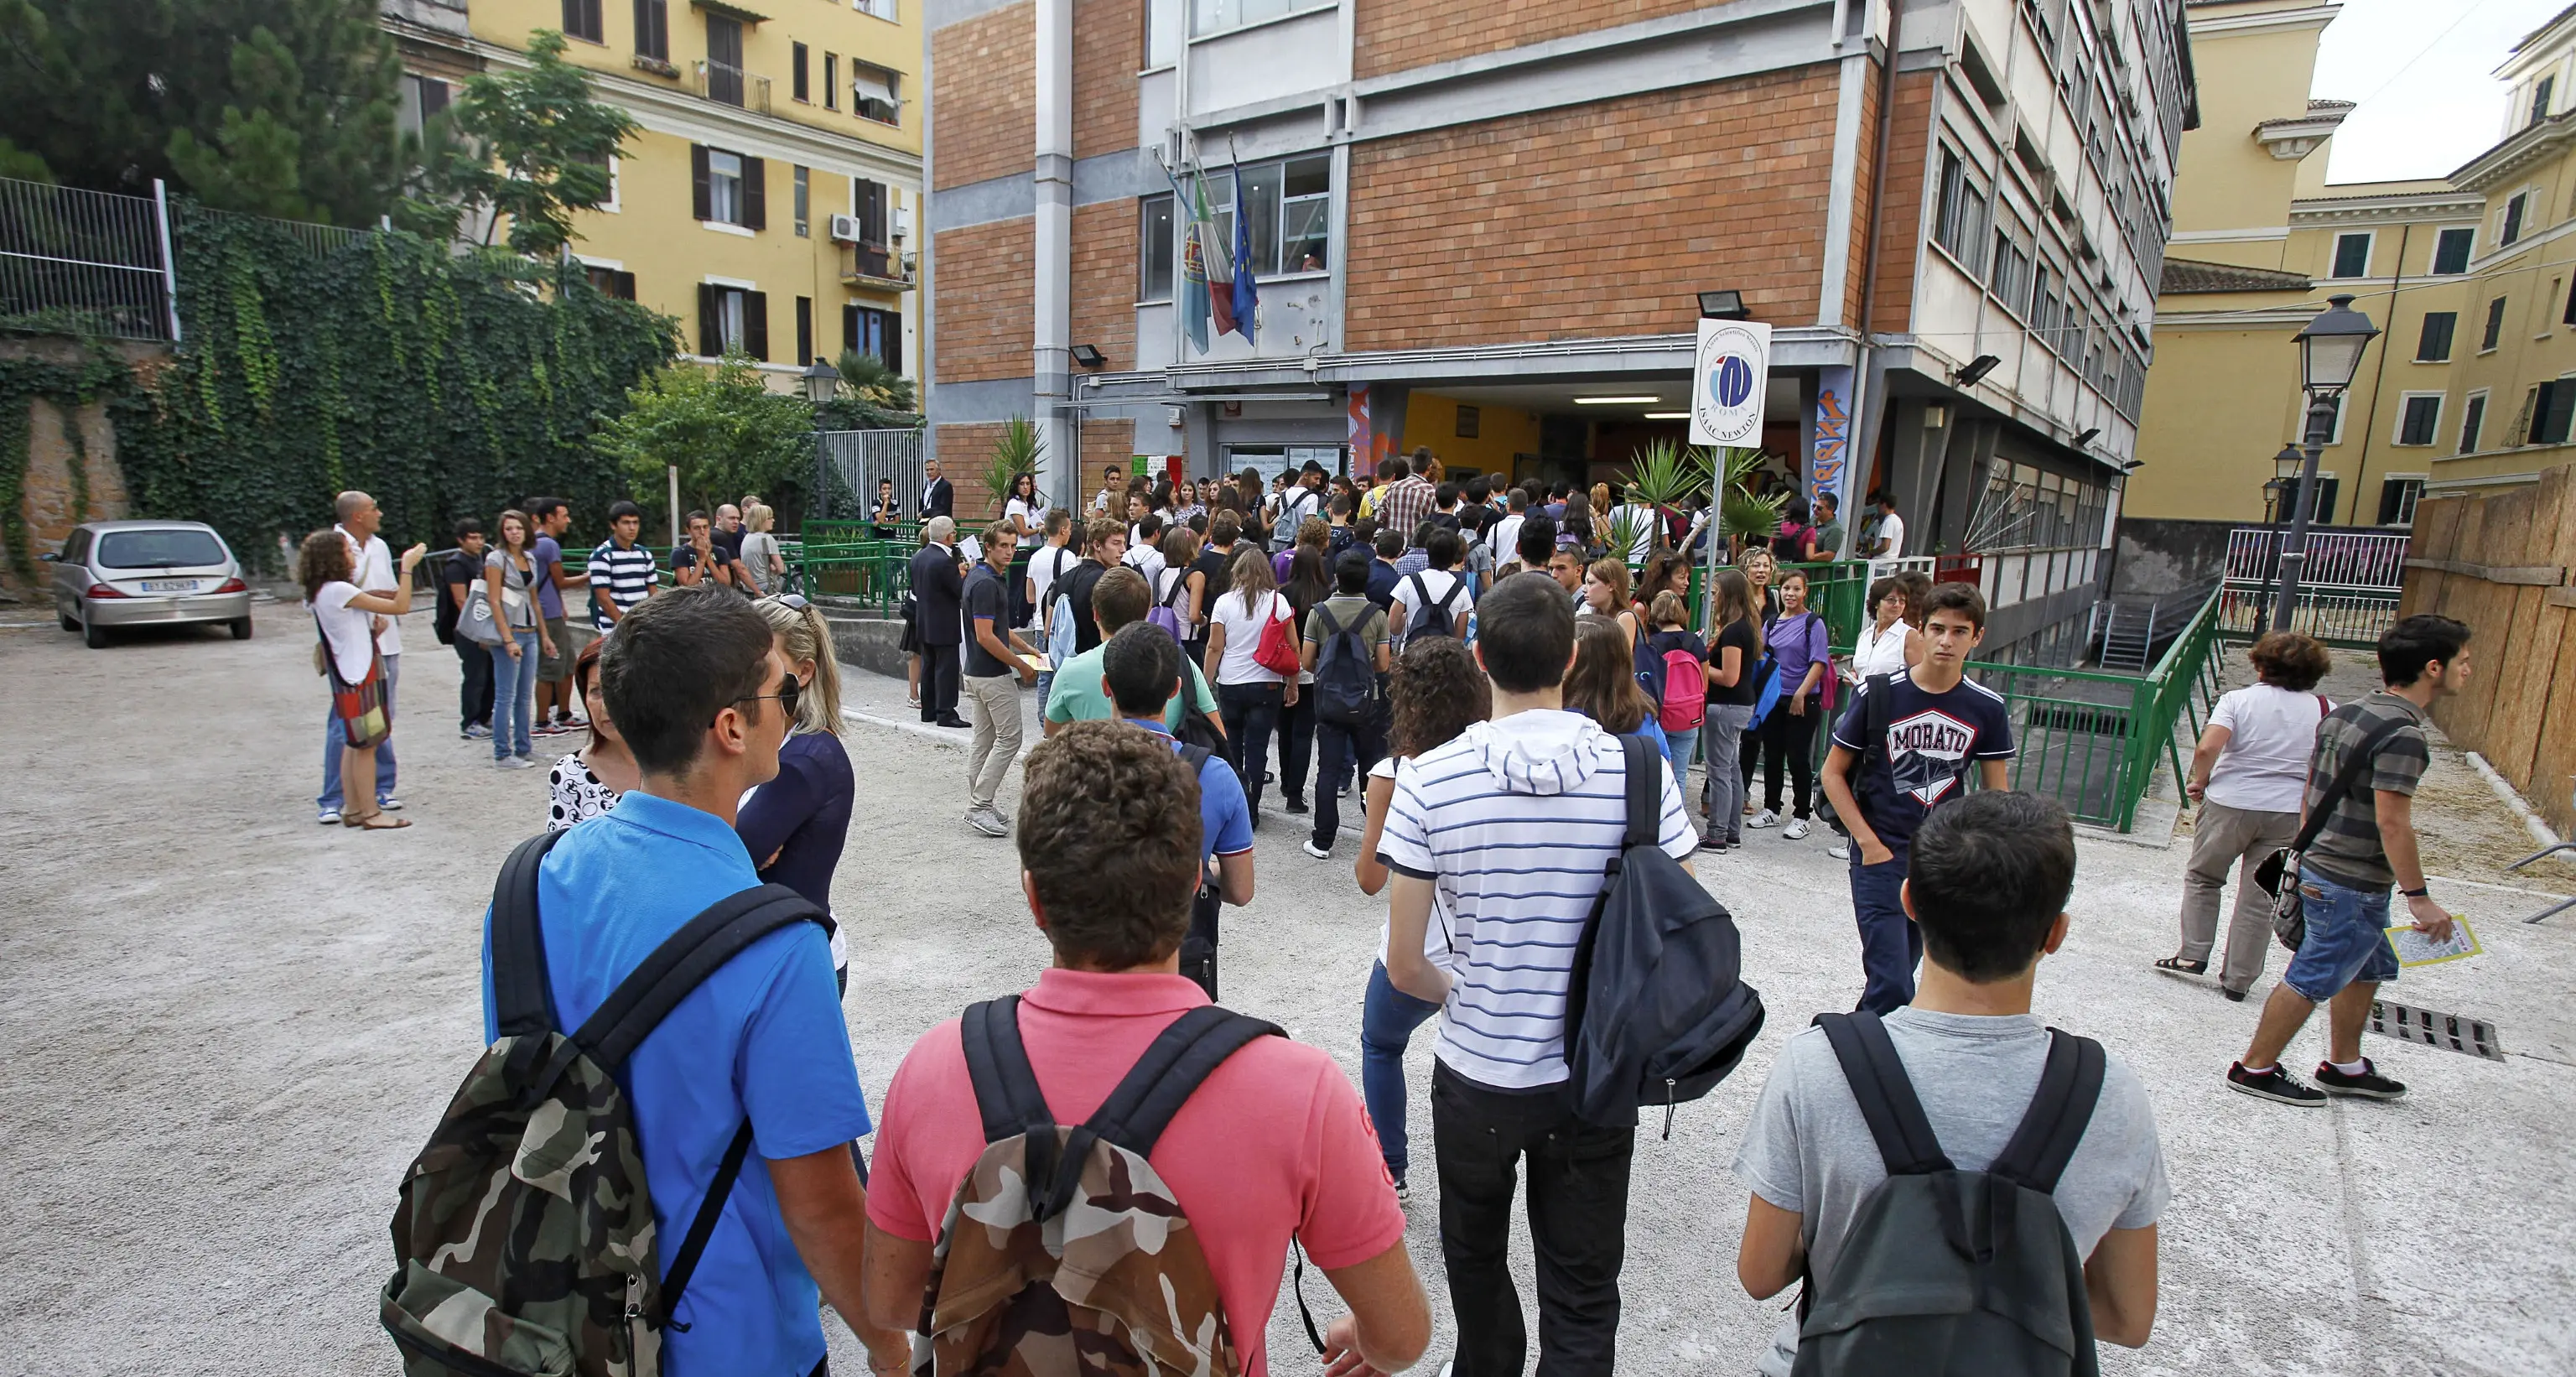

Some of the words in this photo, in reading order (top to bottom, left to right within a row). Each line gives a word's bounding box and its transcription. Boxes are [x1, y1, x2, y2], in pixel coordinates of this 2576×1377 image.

[1700, 408, 1719, 436] ISAAC
[1722, 411, 1755, 439] NEWTON
[1711, 403, 1747, 417] ROMA
[1893, 722, 1968, 753] MORATO
